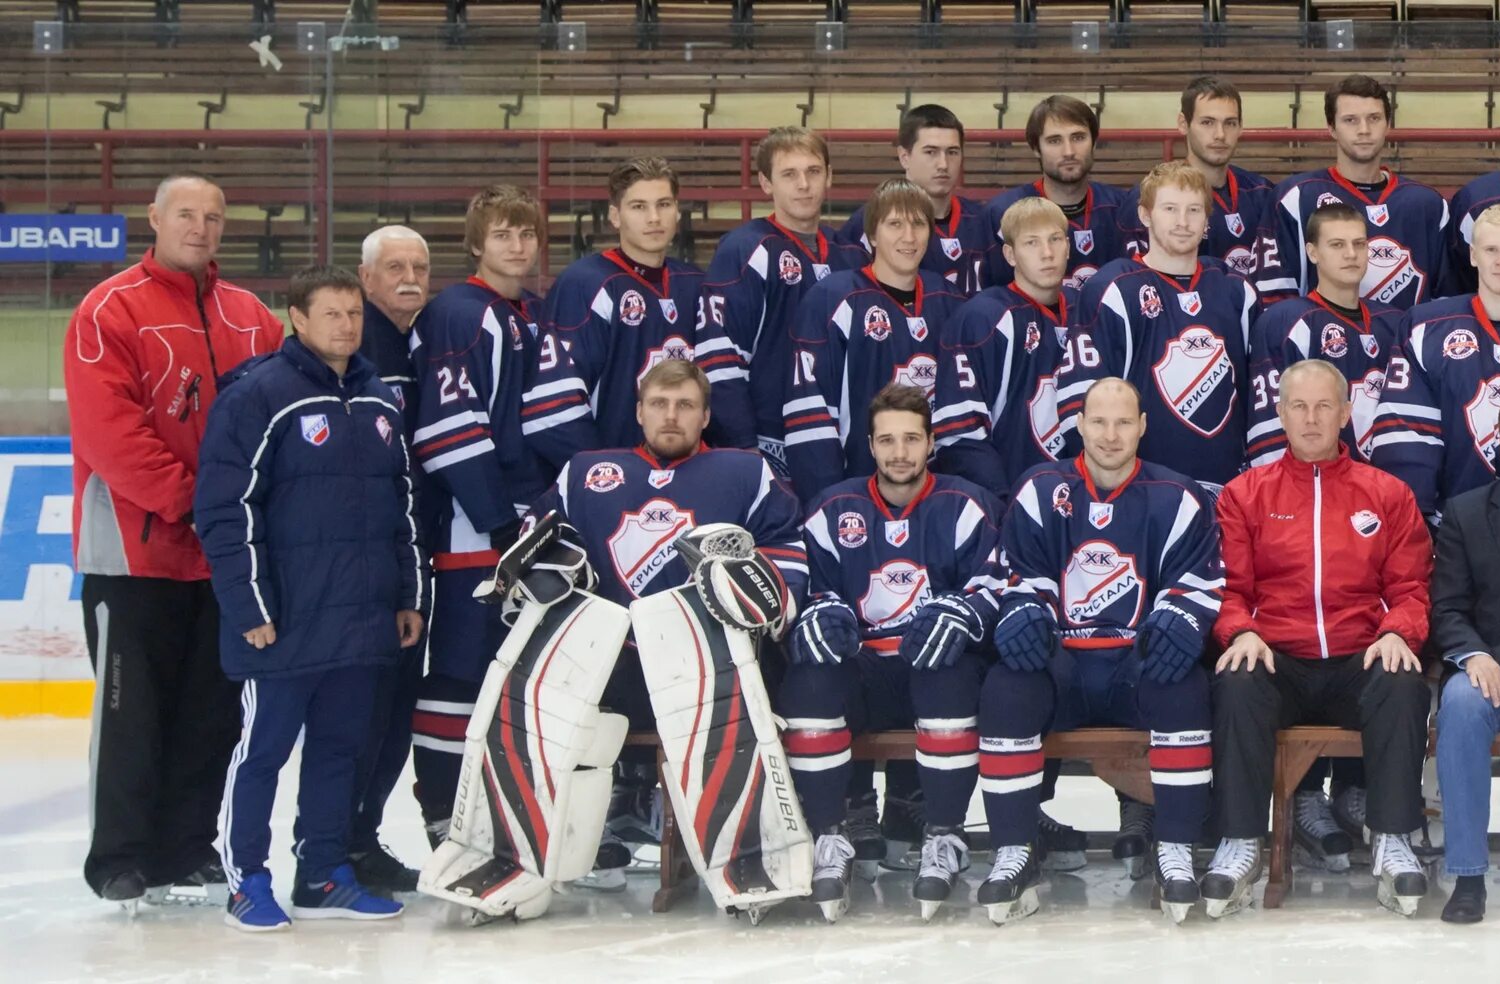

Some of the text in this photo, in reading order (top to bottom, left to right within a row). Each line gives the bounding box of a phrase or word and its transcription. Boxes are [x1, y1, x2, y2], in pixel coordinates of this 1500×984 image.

[0, 227, 119, 248] UBARU
[1371, 246, 1394, 260] ХК
[628, 296, 640, 307] 70
[1329, 329, 1341, 340] 70
[1454, 334, 1467, 343] 70
[1187, 337, 1212, 349] ХК
[666, 347, 687, 359] ХК
[913, 365, 936, 377] ХК
[955, 353, 976, 388] 5
[599, 468, 612, 476] 70
[644, 509, 671, 523] ХК
[846, 518, 859, 529] 70
[1085, 551, 1112, 565] ХК
[630, 545, 677, 591] КРИСТА
[887, 572, 913, 584] ХК
[743, 564, 778, 609] BAUER
[1178, 734, 1205, 743] Reebok
[768, 754, 798, 832] BAUER
